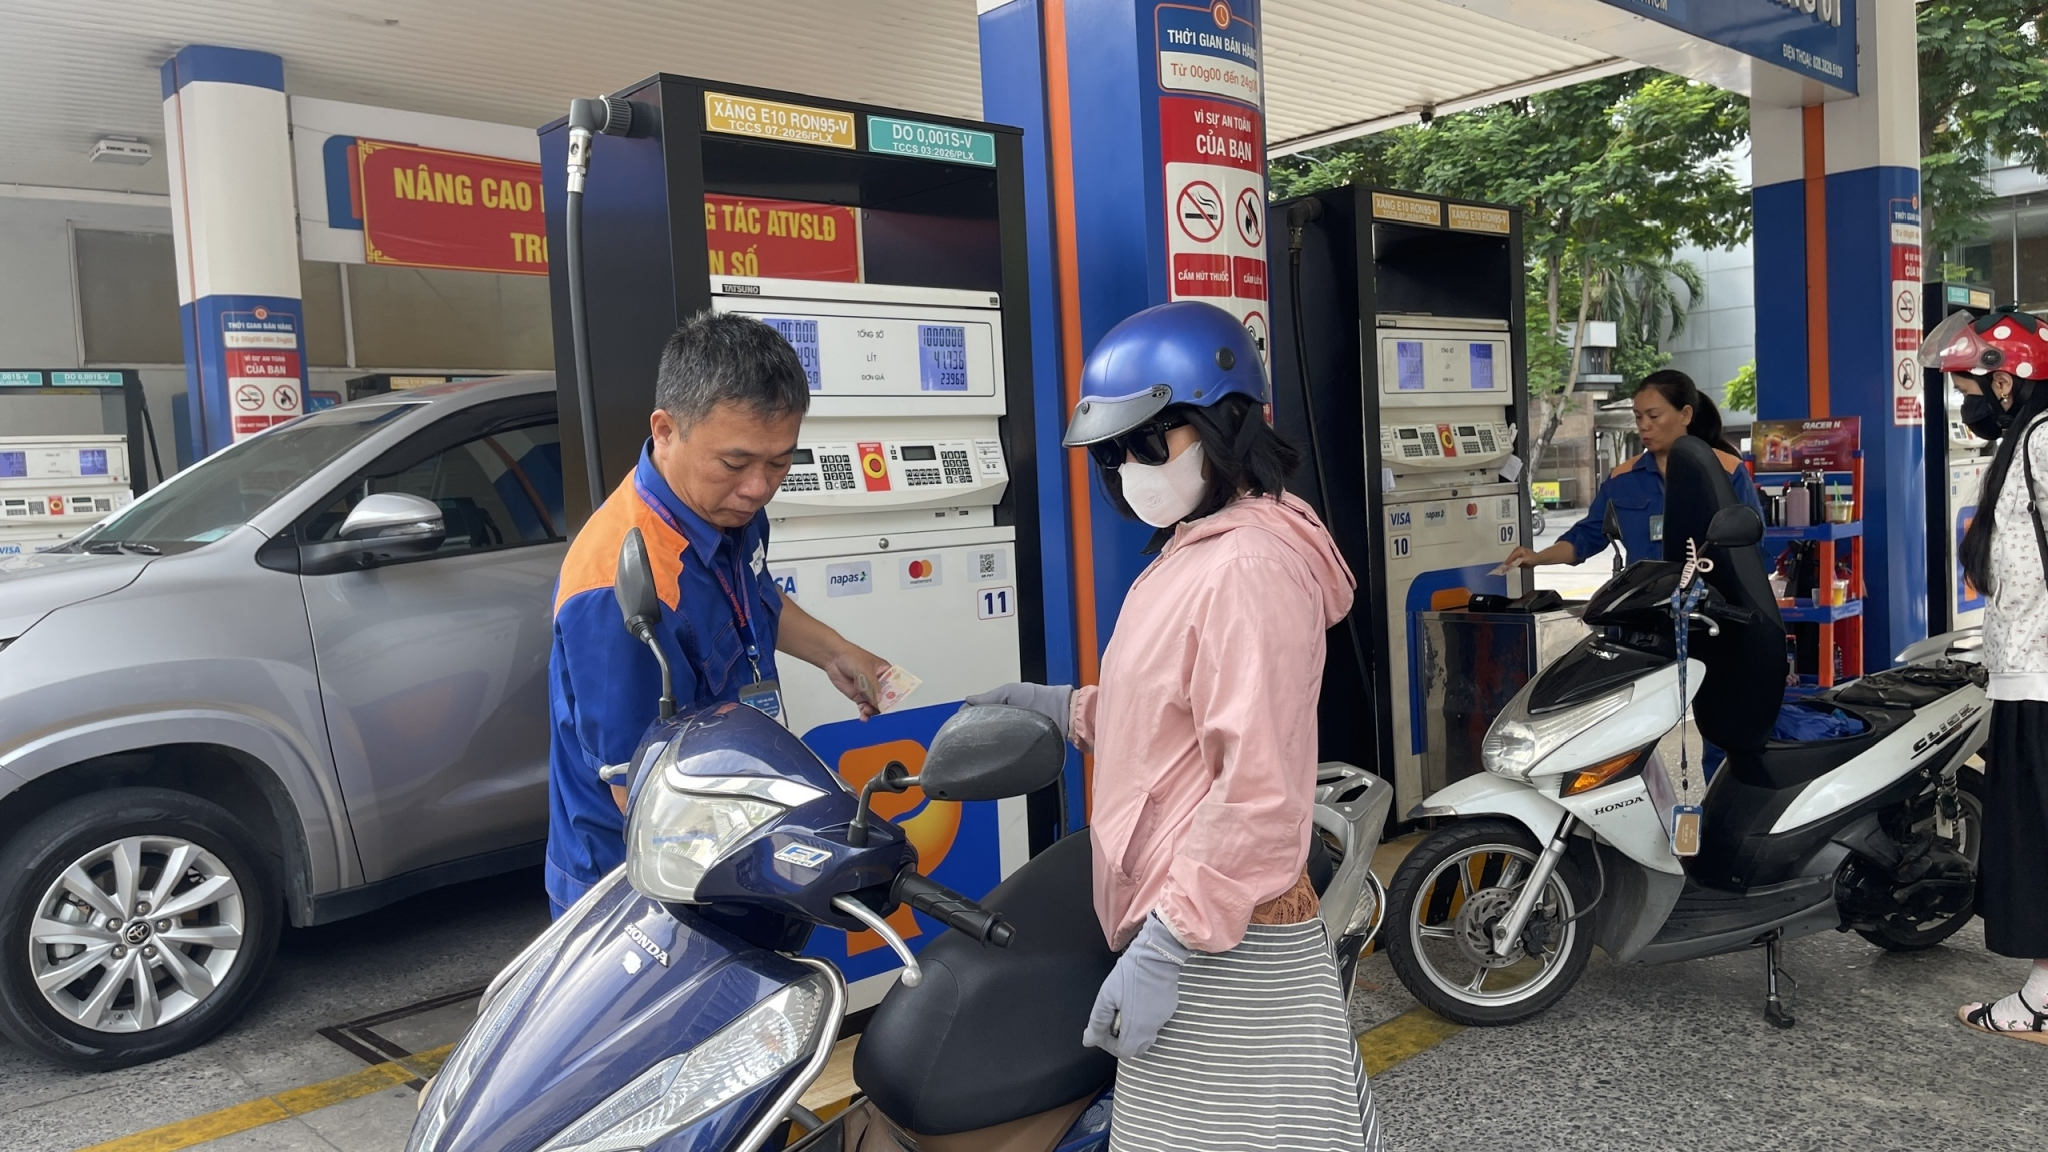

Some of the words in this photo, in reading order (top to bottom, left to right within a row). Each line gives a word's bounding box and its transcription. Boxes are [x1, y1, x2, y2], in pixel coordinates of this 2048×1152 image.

[1167, 28, 1196, 45] THỜI
[1199, 32, 1223, 49] GIAN
[1224, 37, 1241, 54] BÁN
[1170, 63, 1188, 77] Từ
[1190, 65, 1221, 82] 00g00
[1223, 70, 1239, 86] đến
[714, 99, 756, 122] XĂNG
[761, 108, 786, 126] E10
[791, 113, 848, 134] RON95-V
[1194, 109, 1204, 123] VÌ
[1206, 112, 1220, 128] SỰ
[1222, 114, 1233, 129] AN
[1234, 117, 1252, 133] TOÀN
[728, 119, 762, 133] TCCS
[765, 125, 833, 143] 07:2026/PLX
[892, 124, 913, 140] DO
[917, 128, 972, 149] 0,001S-V
[892, 142, 918, 153] TCCS
[921, 146, 974, 160] 03:2026/PLX
[1196, 129, 1226, 157] CỦA
[1229, 139, 1252, 164] BẠN
[394, 164, 473, 206] NÂNG
[481, 178, 532, 212] CAO
[722, 202, 761, 235] TÁC
[767, 209, 836, 242] ATVSLĐ
[731, 244, 759, 277] SỐ
[1178, 268, 1194, 281] CẤM
[1196, 270, 1209, 281] HÚT
[722, 284, 759, 294] TATSUNO
[856, 329, 874, 339] TỔNG
[875, 329, 885, 339] SỐ
[923, 327, 963, 347] 1000000
[866, 352, 877, 362] LÍT
[246, 362, 265, 374] CỦA
[267, 365, 286, 376] BẠN
[941, 372, 965, 386] 23960
[1389, 512, 1411, 526] VISA
[1500, 526, 1513, 542] 09
[1394, 538, 1408, 556] 10
[774, 576, 796, 594] SA
[830, 573, 859, 586] napas
[985, 591, 1007, 615] 11
[1594, 796, 1645, 815] HONDA
[624, 922, 668, 967] HONDA
